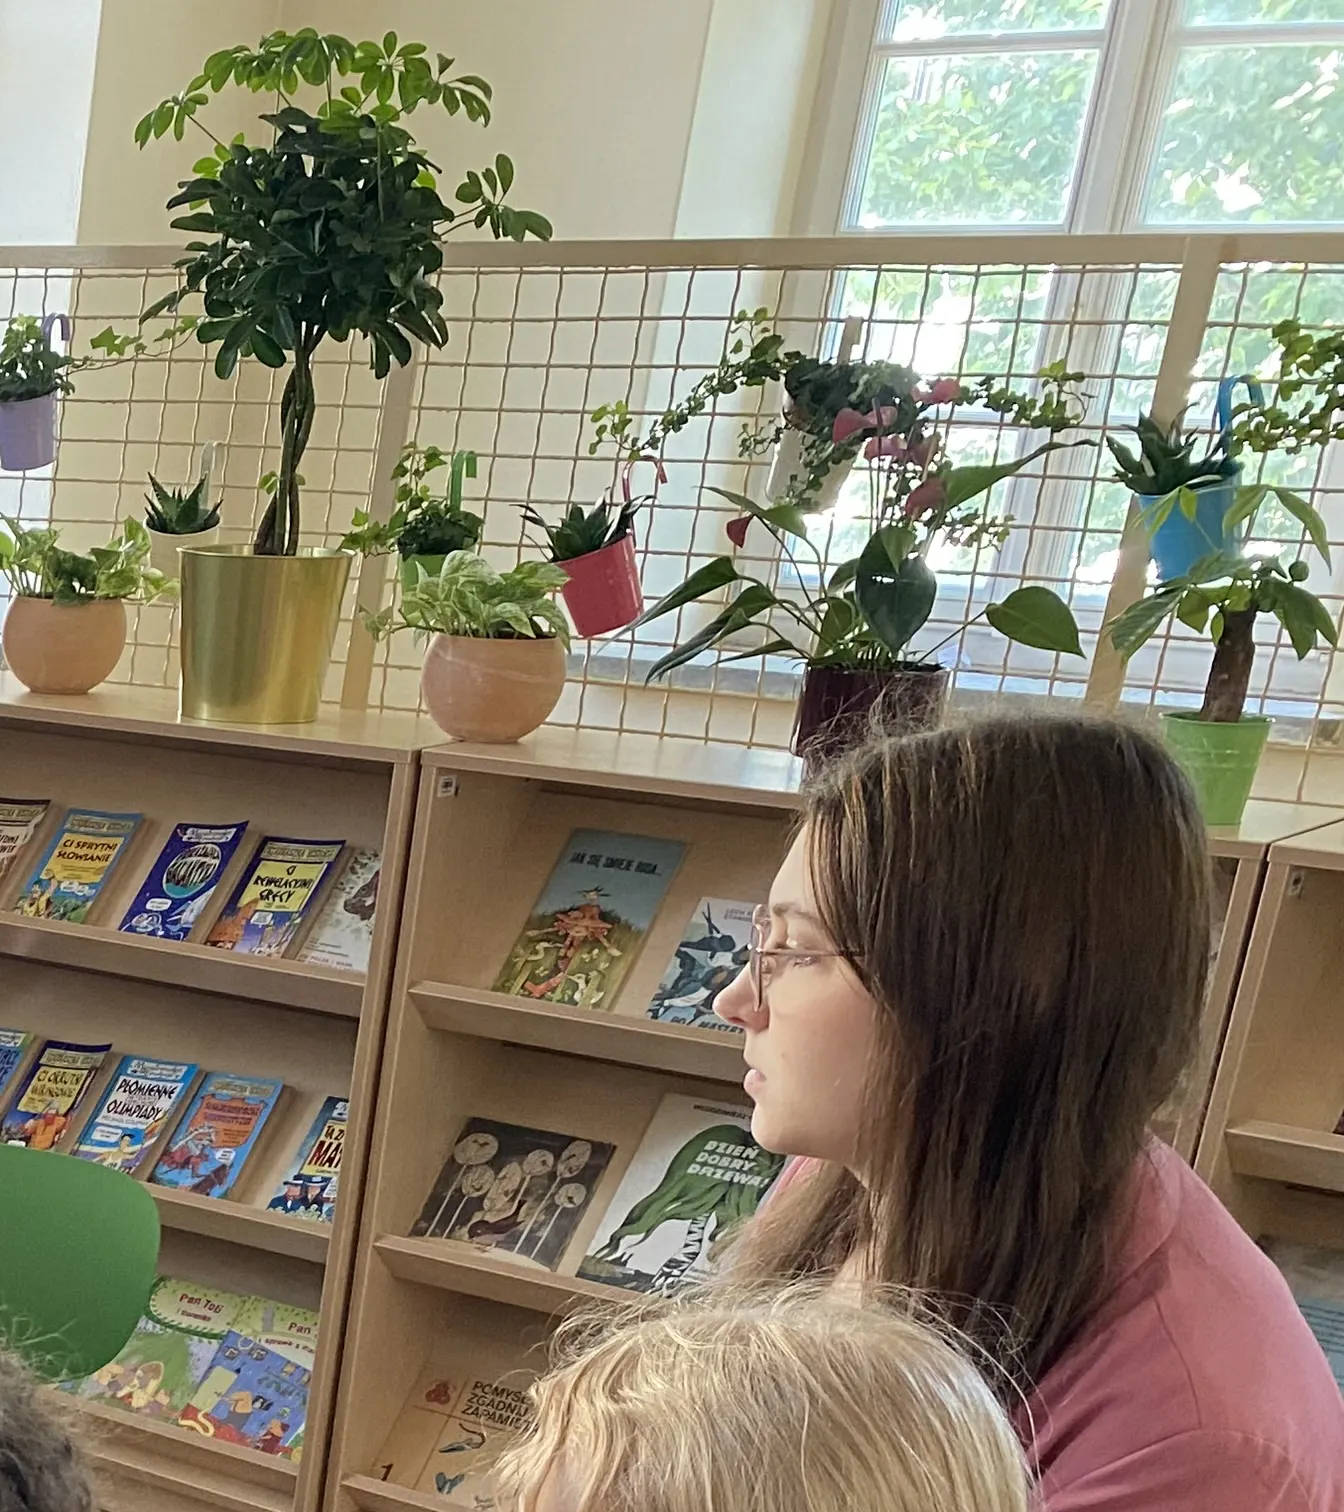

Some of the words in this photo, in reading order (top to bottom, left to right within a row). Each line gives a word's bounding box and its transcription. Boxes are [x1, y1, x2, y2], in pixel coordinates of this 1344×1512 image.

[74, 840, 118, 851] SPRYTNI
[57, 850, 112, 862] SŁOWIANIE
[116, 1078, 178, 1100] PŁOMIENNE
[107, 1099, 163, 1121] OLIMPIADY
[704, 1140, 760, 1160] DZIEŃ
[695, 1151, 758, 1171] DOBRY
[686, 1163, 771, 1188] DRZEWA!
[179, 1293, 201, 1305] Pan
[288, 1322, 311, 1334] Pan
[467, 1392, 529, 1417] ZGADNIJ
[380, 1463, 394, 1482] 1
